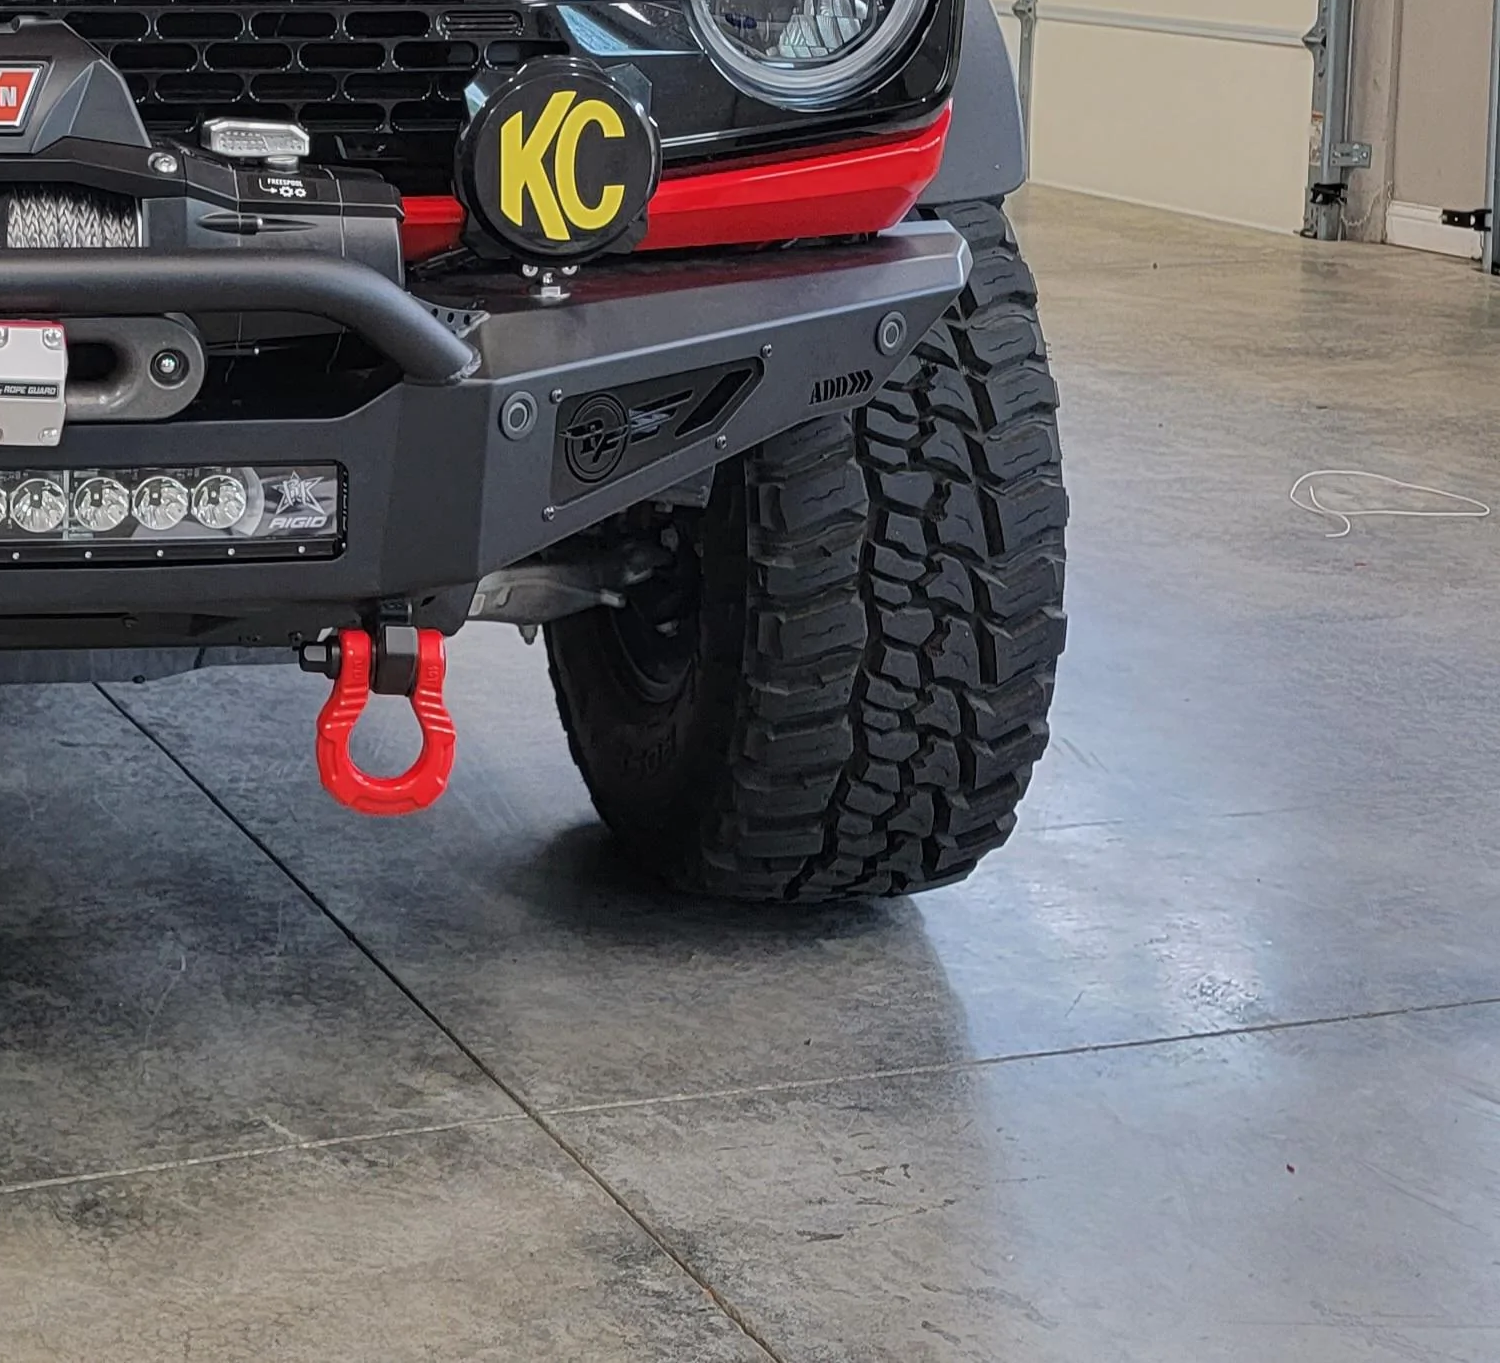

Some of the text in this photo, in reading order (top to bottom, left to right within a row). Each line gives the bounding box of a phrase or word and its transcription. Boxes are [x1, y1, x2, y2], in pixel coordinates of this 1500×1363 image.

[501, 90, 626, 241] KC
[267, 177, 303, 187] FREESPOOL
[4, 384, 27, 395] ROPE
[27, 385, 58, 396] GUARD
[268, 516, 328, 529] RIGID
